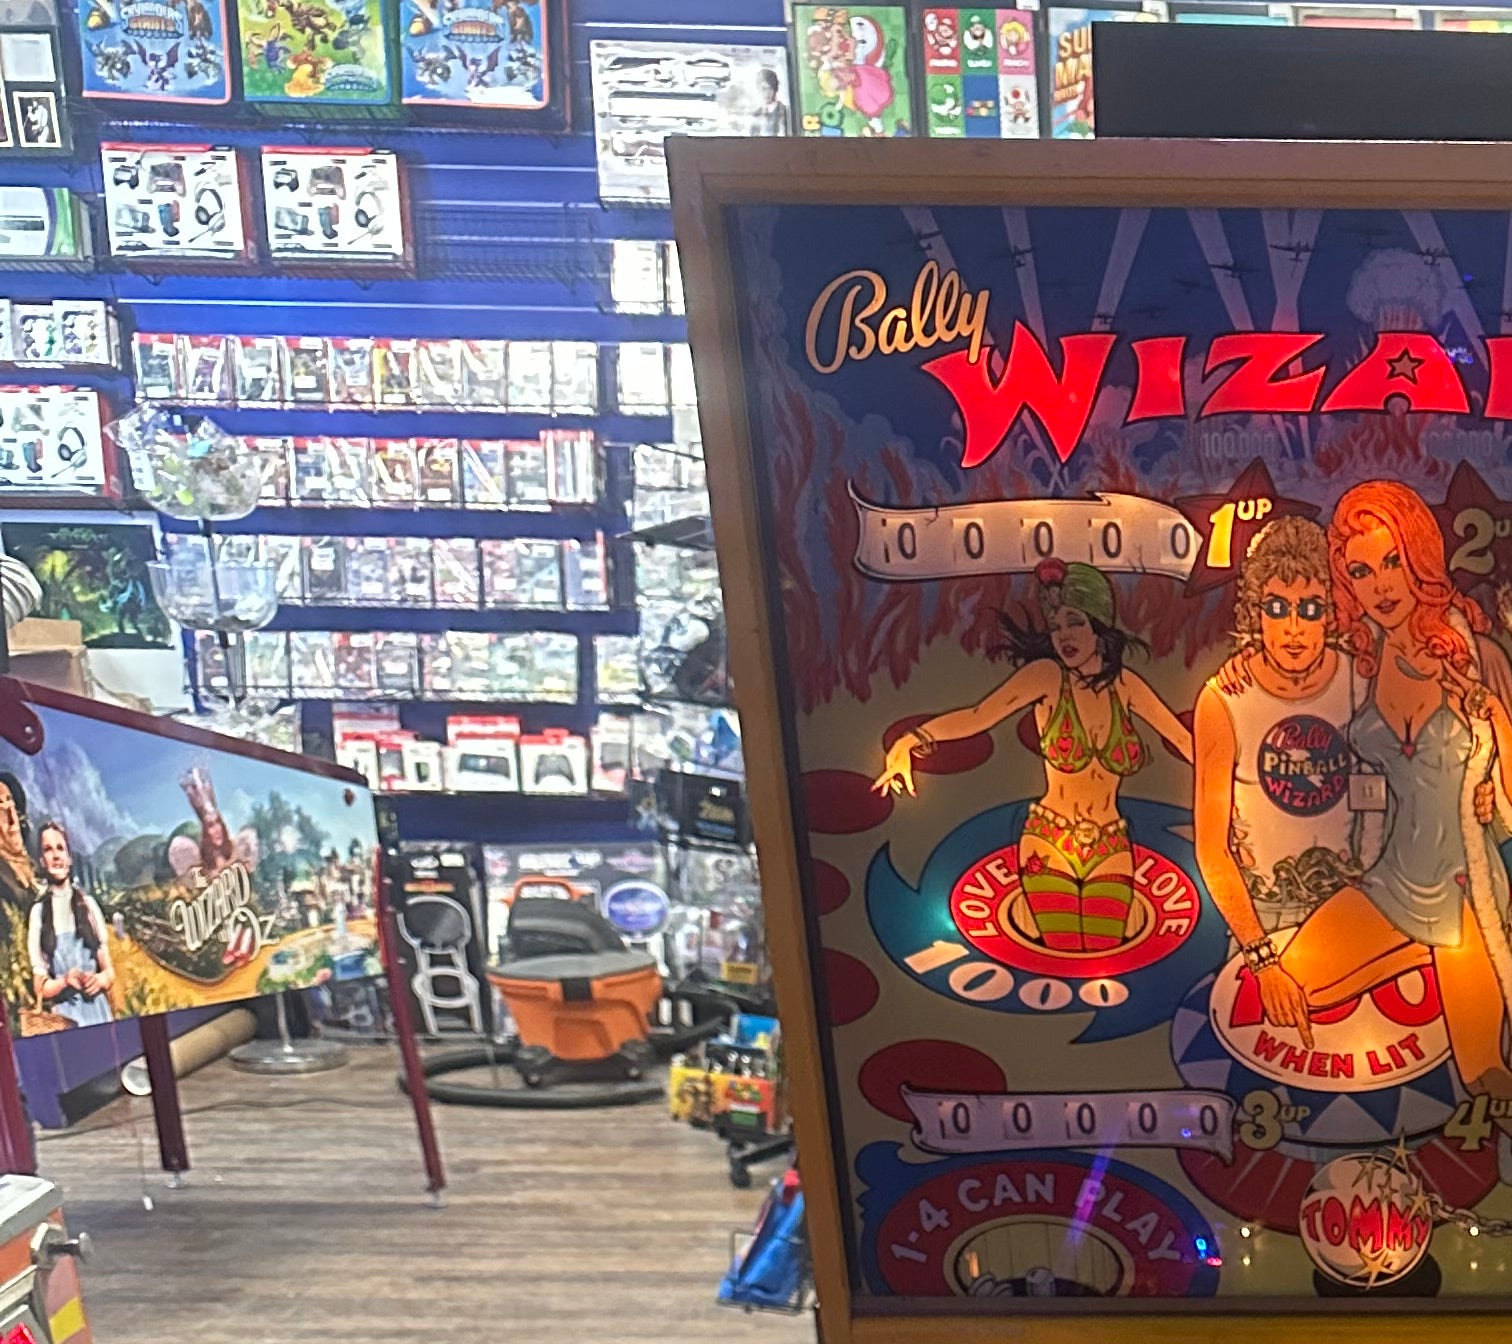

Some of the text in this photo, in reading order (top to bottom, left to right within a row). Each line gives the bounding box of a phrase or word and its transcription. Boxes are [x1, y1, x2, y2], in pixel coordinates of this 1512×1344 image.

[805, 260, 990, 374] Bally
[958, 856, 1190, 938] LOVE LOVE
[903, 939, 1130, 1011] 1000
[1252, 1029, 1426, 1080] WHEN LIT
[958, 1172, 1056, 1213] CAN
[1075, 1178, 1182, 1263] PLAY
[1301, 1193, 1431, 1254] TOMMY
